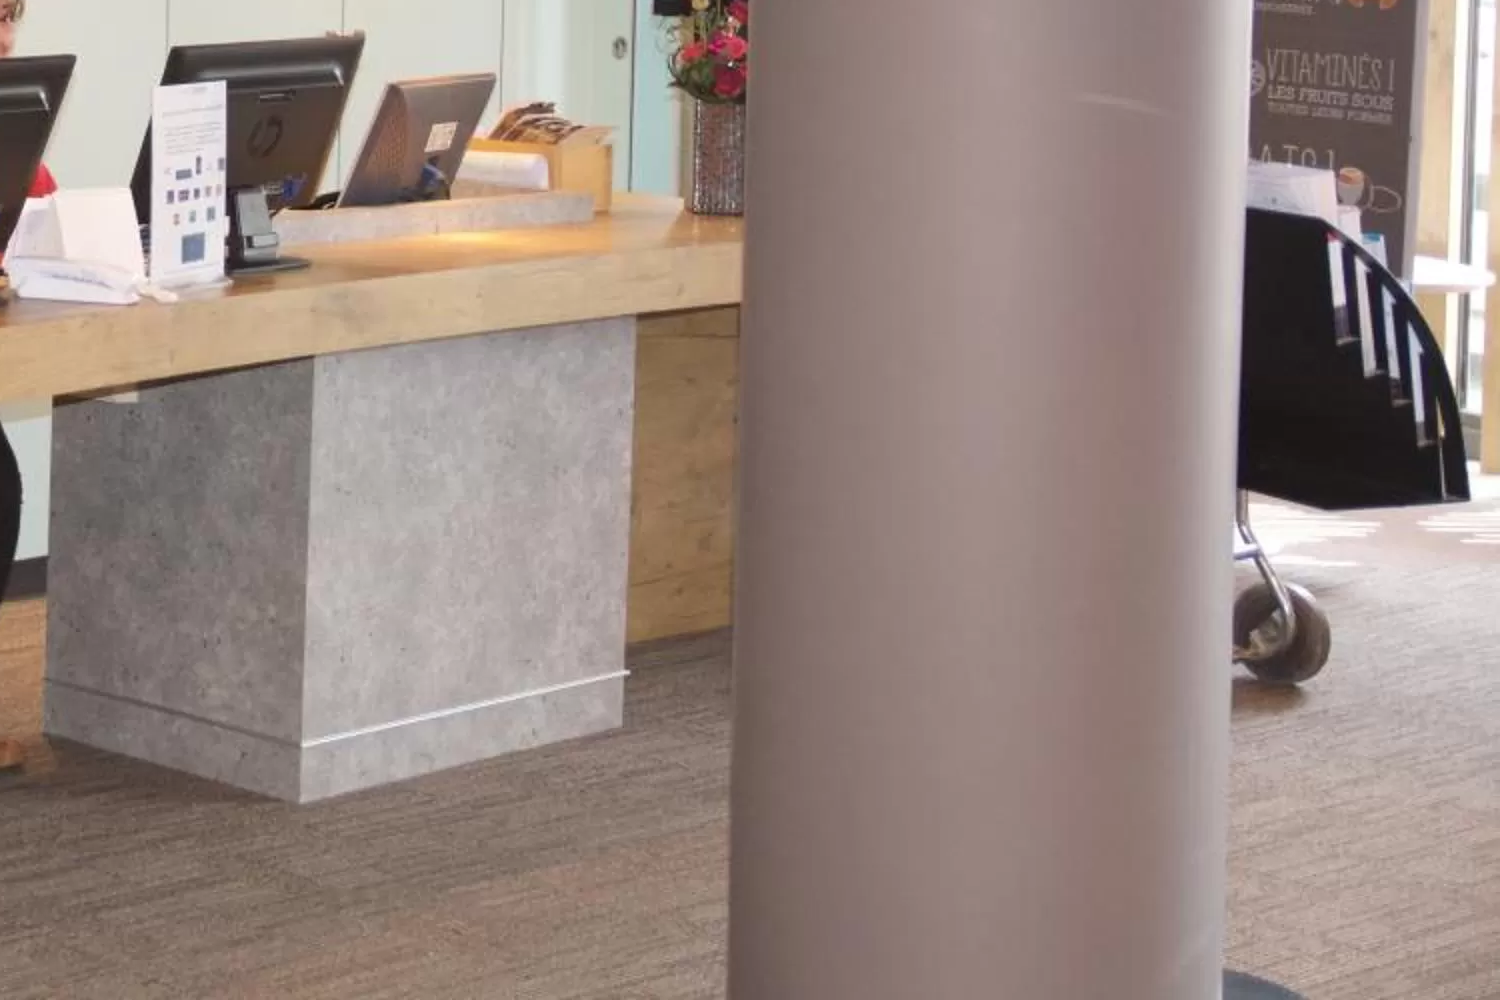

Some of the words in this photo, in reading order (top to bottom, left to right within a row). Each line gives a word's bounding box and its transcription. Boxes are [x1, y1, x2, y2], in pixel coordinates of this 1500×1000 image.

[1267, 85, 1296, 100] LES
[1299, 87, 1349, 106] FRUITS
[1351, 92, 1395, 112] SOUS
